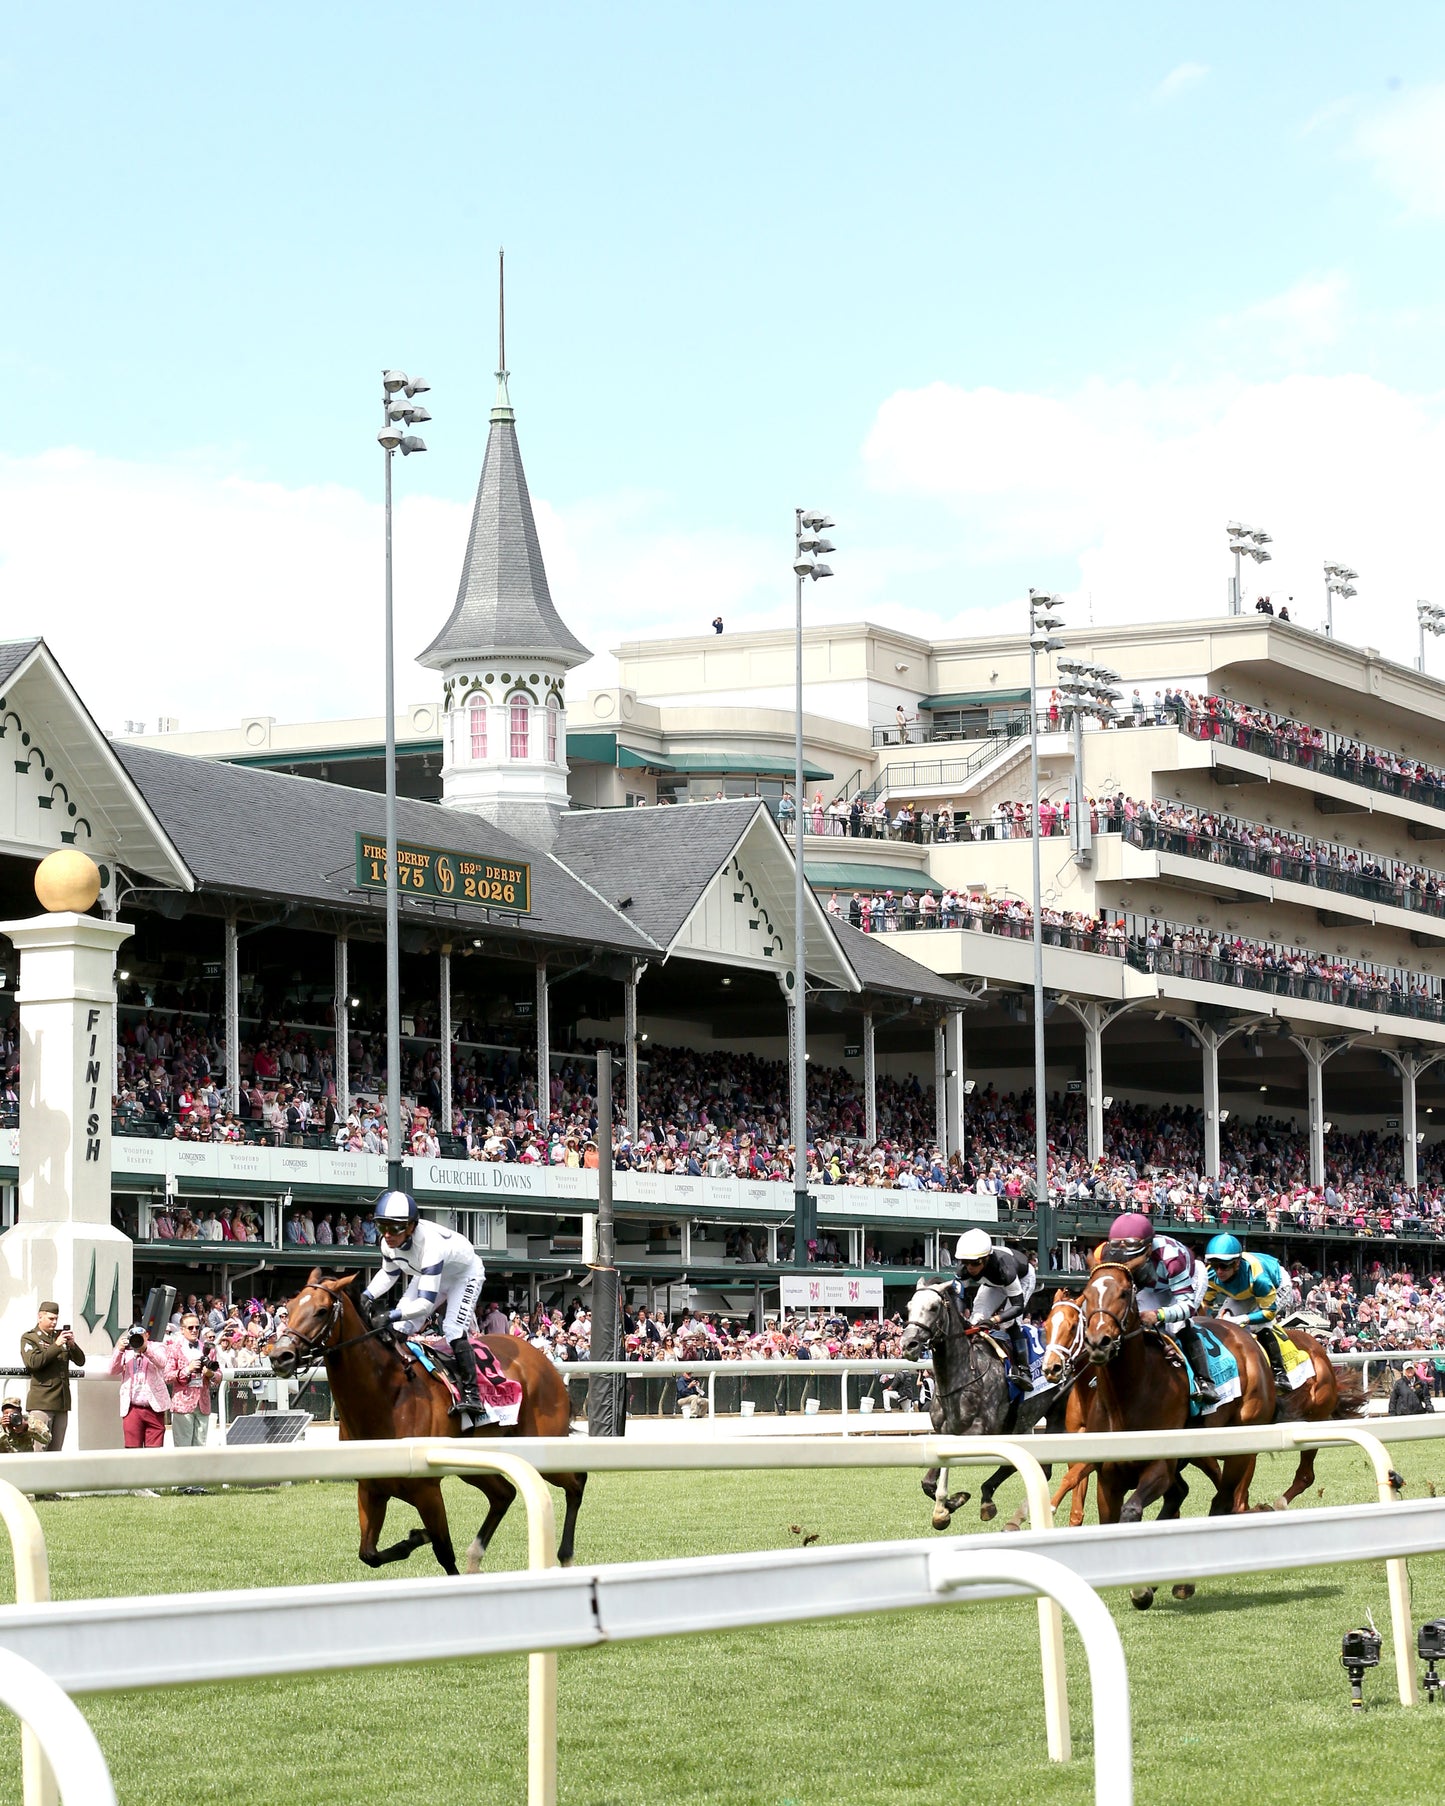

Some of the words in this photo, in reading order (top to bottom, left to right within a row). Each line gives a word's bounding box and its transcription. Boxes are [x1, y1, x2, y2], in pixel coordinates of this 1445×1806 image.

[363, 844, 388, 860] FIRS
[397, 850, 430, 868] DERBY
[486, 866, 522, 884] DERBY
[464, 877, 515, 904] 2026
[86, 1009, 101, 1162] FINISH
[123, 1147, 154, 1156] WOODFORD
[126, 1156, 152, 1165] RESERVE
[178, 1152, 206, 1162] LONGINES
[230, 1154, 260, 1162] WOODFORD
[233, 1163, 258, 1171] RESERVE
[282, 1159, 308, 1168] LONGINES
[330, 1160, 358, 1168] WOODFORD
[333, 1169, 356, 1177] RESERVE
[430, 1165, 488, 1187] CHURCHILL
[493, 1169, 532, 1189] DOWNS
[674, 1184, 694, 1193] LONGINES
